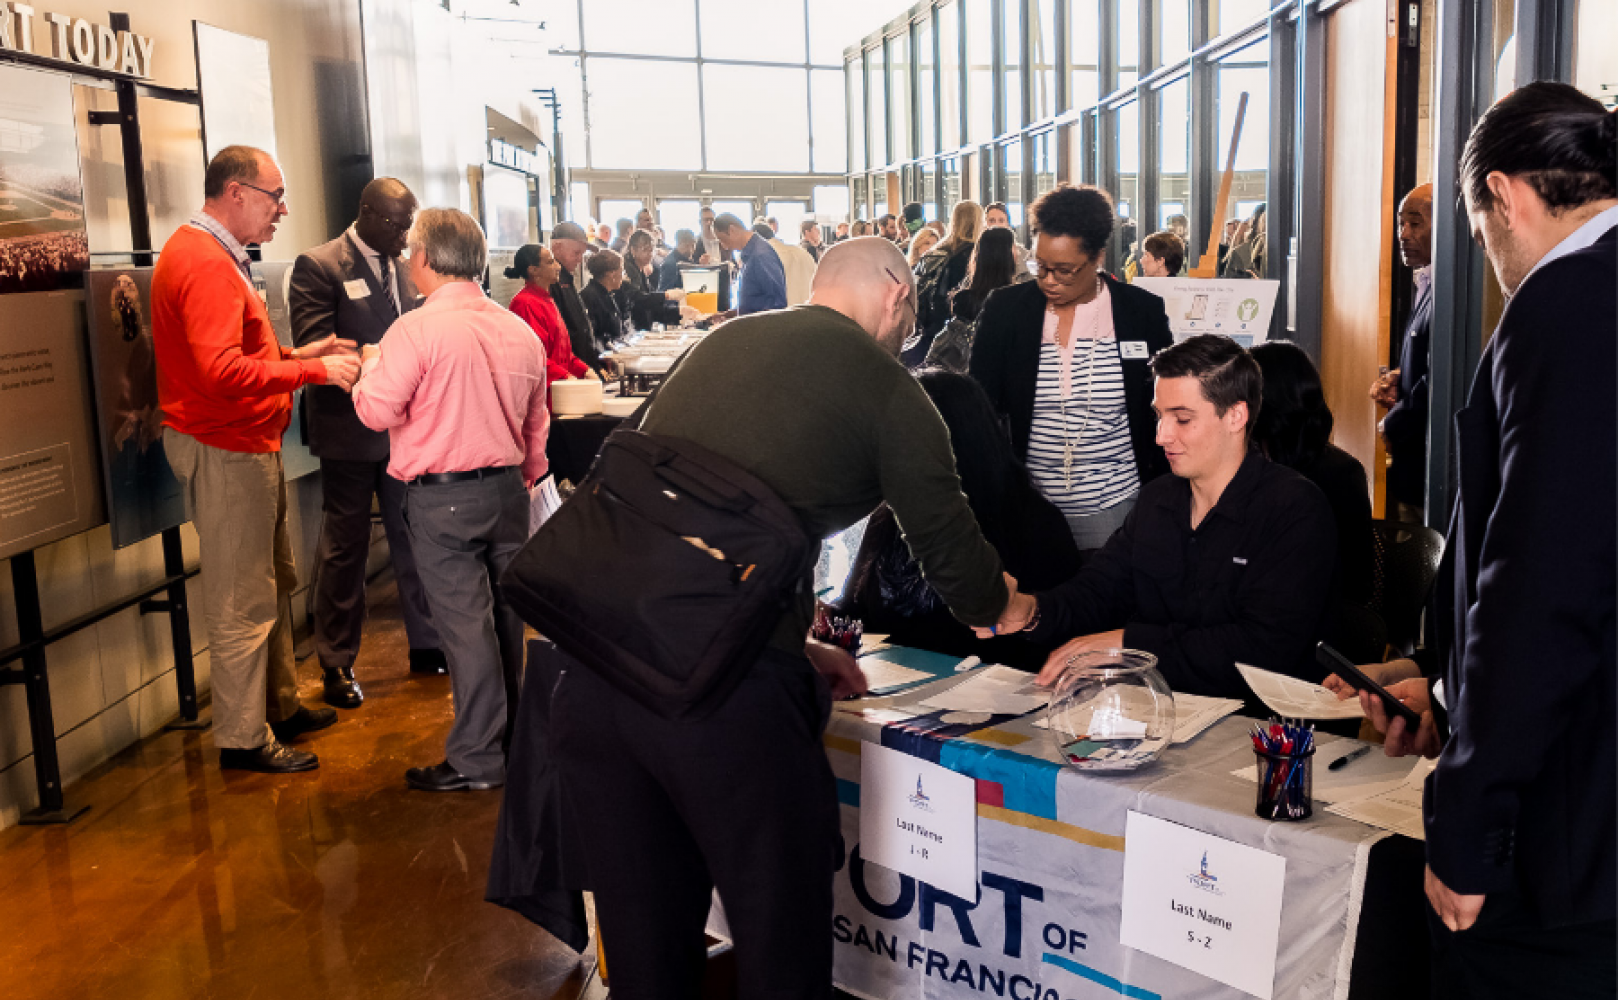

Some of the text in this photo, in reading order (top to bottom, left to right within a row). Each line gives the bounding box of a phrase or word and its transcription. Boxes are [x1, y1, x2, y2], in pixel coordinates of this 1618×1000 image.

[50, 11, 154, 78] TODAY
[896, 817, 942, 844] Last Name
[833, 835, 1088, 959] ORT OF
[1171, 898, 1232, 931] Last Name
[833, 914, 898, 962] SAN
